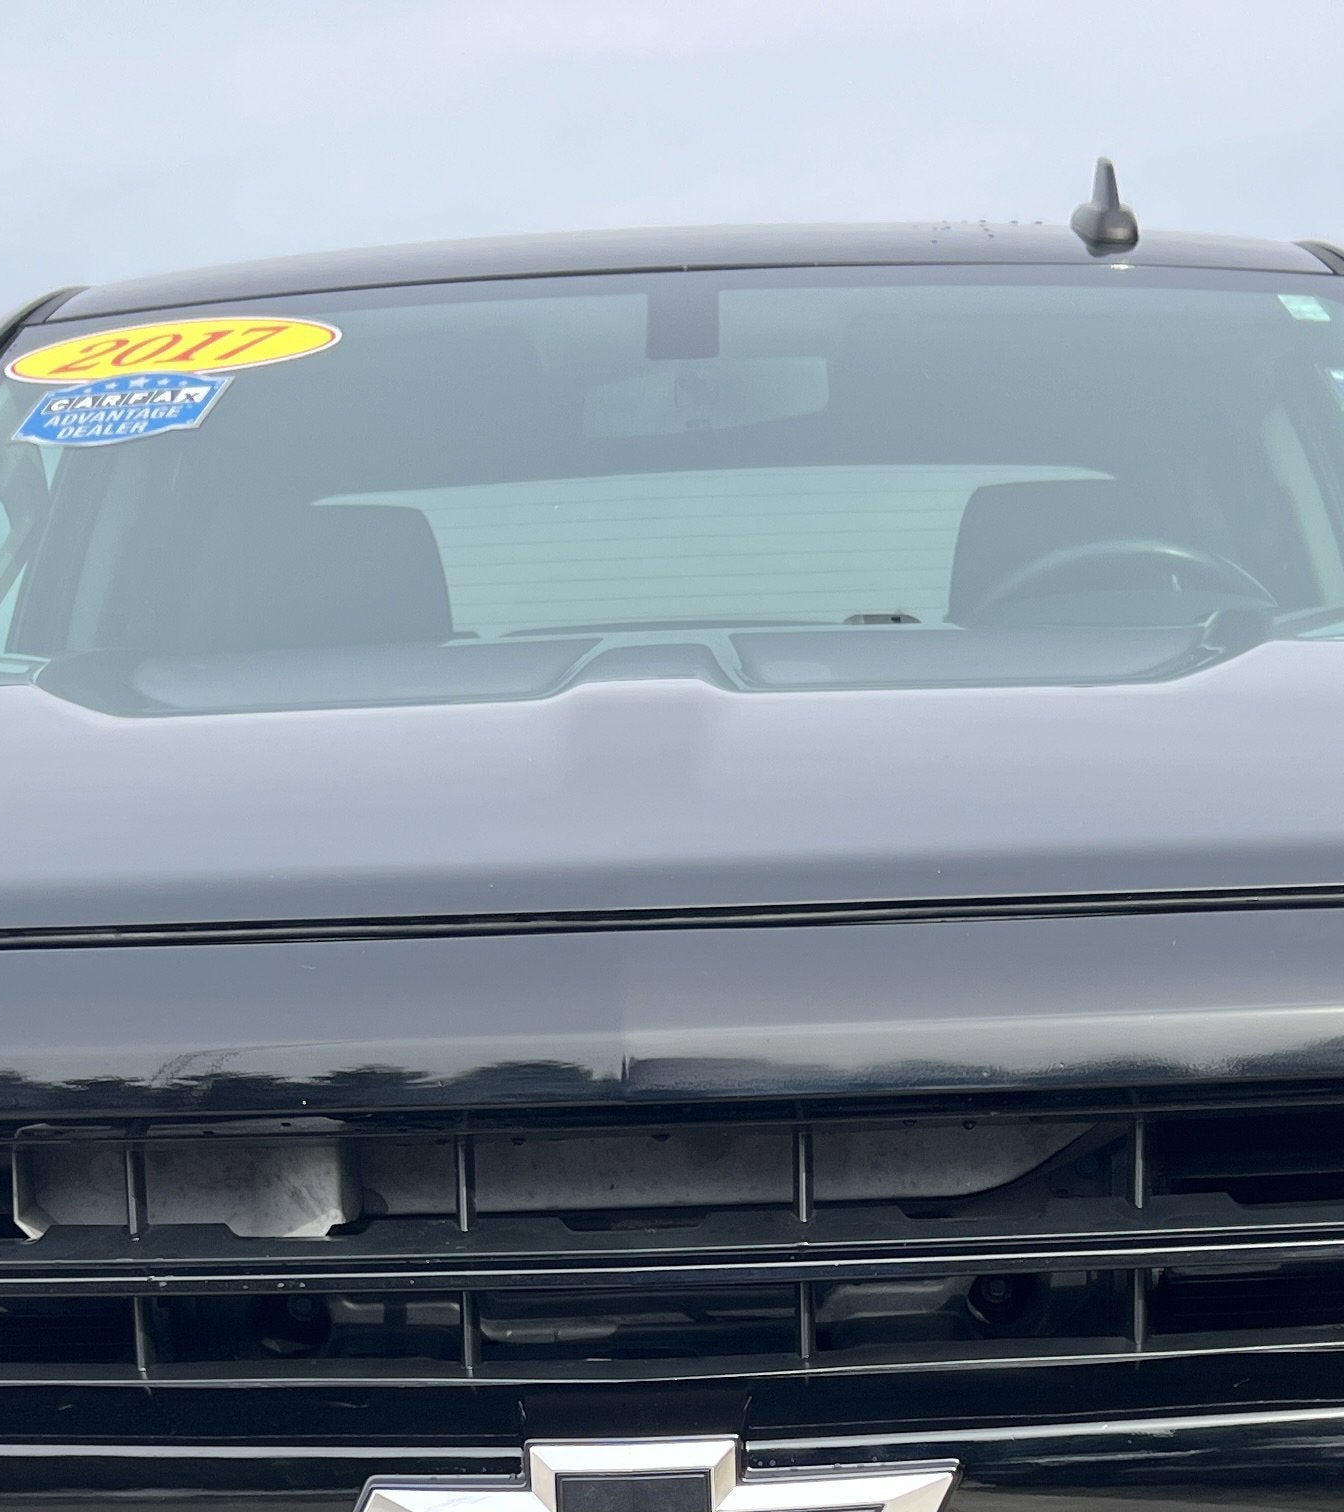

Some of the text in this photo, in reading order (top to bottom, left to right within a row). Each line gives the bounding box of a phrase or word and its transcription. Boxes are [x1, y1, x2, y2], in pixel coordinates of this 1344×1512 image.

[48, 326, 292, 375] 2017
[47, 388, 208, 413] CARFAX
[43, 405, 184, 429] ADVANTAGE
[56, 420, 150, 440] DEALER
